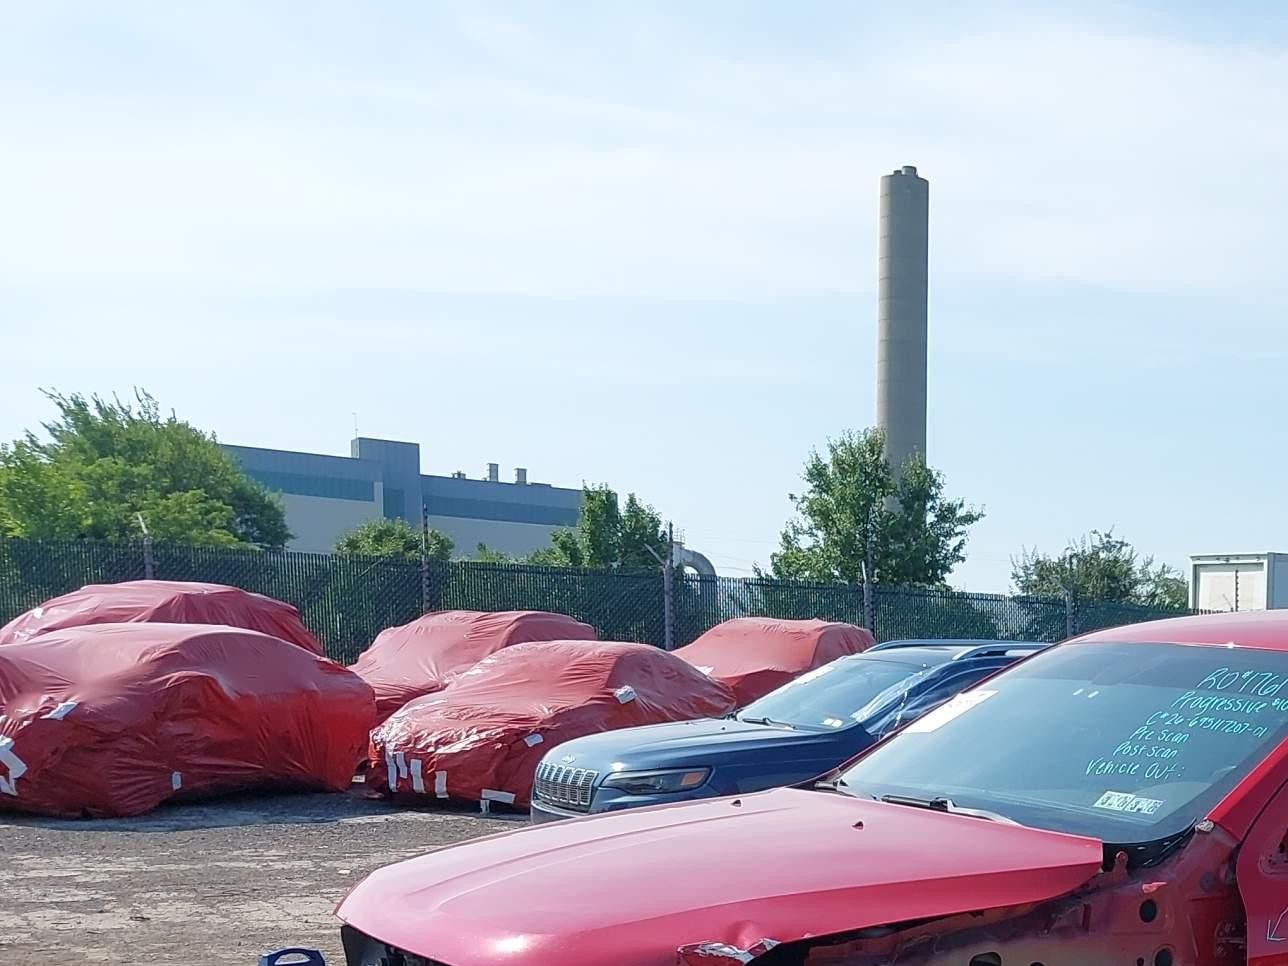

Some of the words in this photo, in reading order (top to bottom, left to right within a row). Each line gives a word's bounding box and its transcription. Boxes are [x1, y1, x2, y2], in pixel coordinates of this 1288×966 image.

[1171, 690, 1268, 716] Progressive
[1129, 725, 1155, 741] Pre
[1086, 757, 1140, 776] Vehicle
